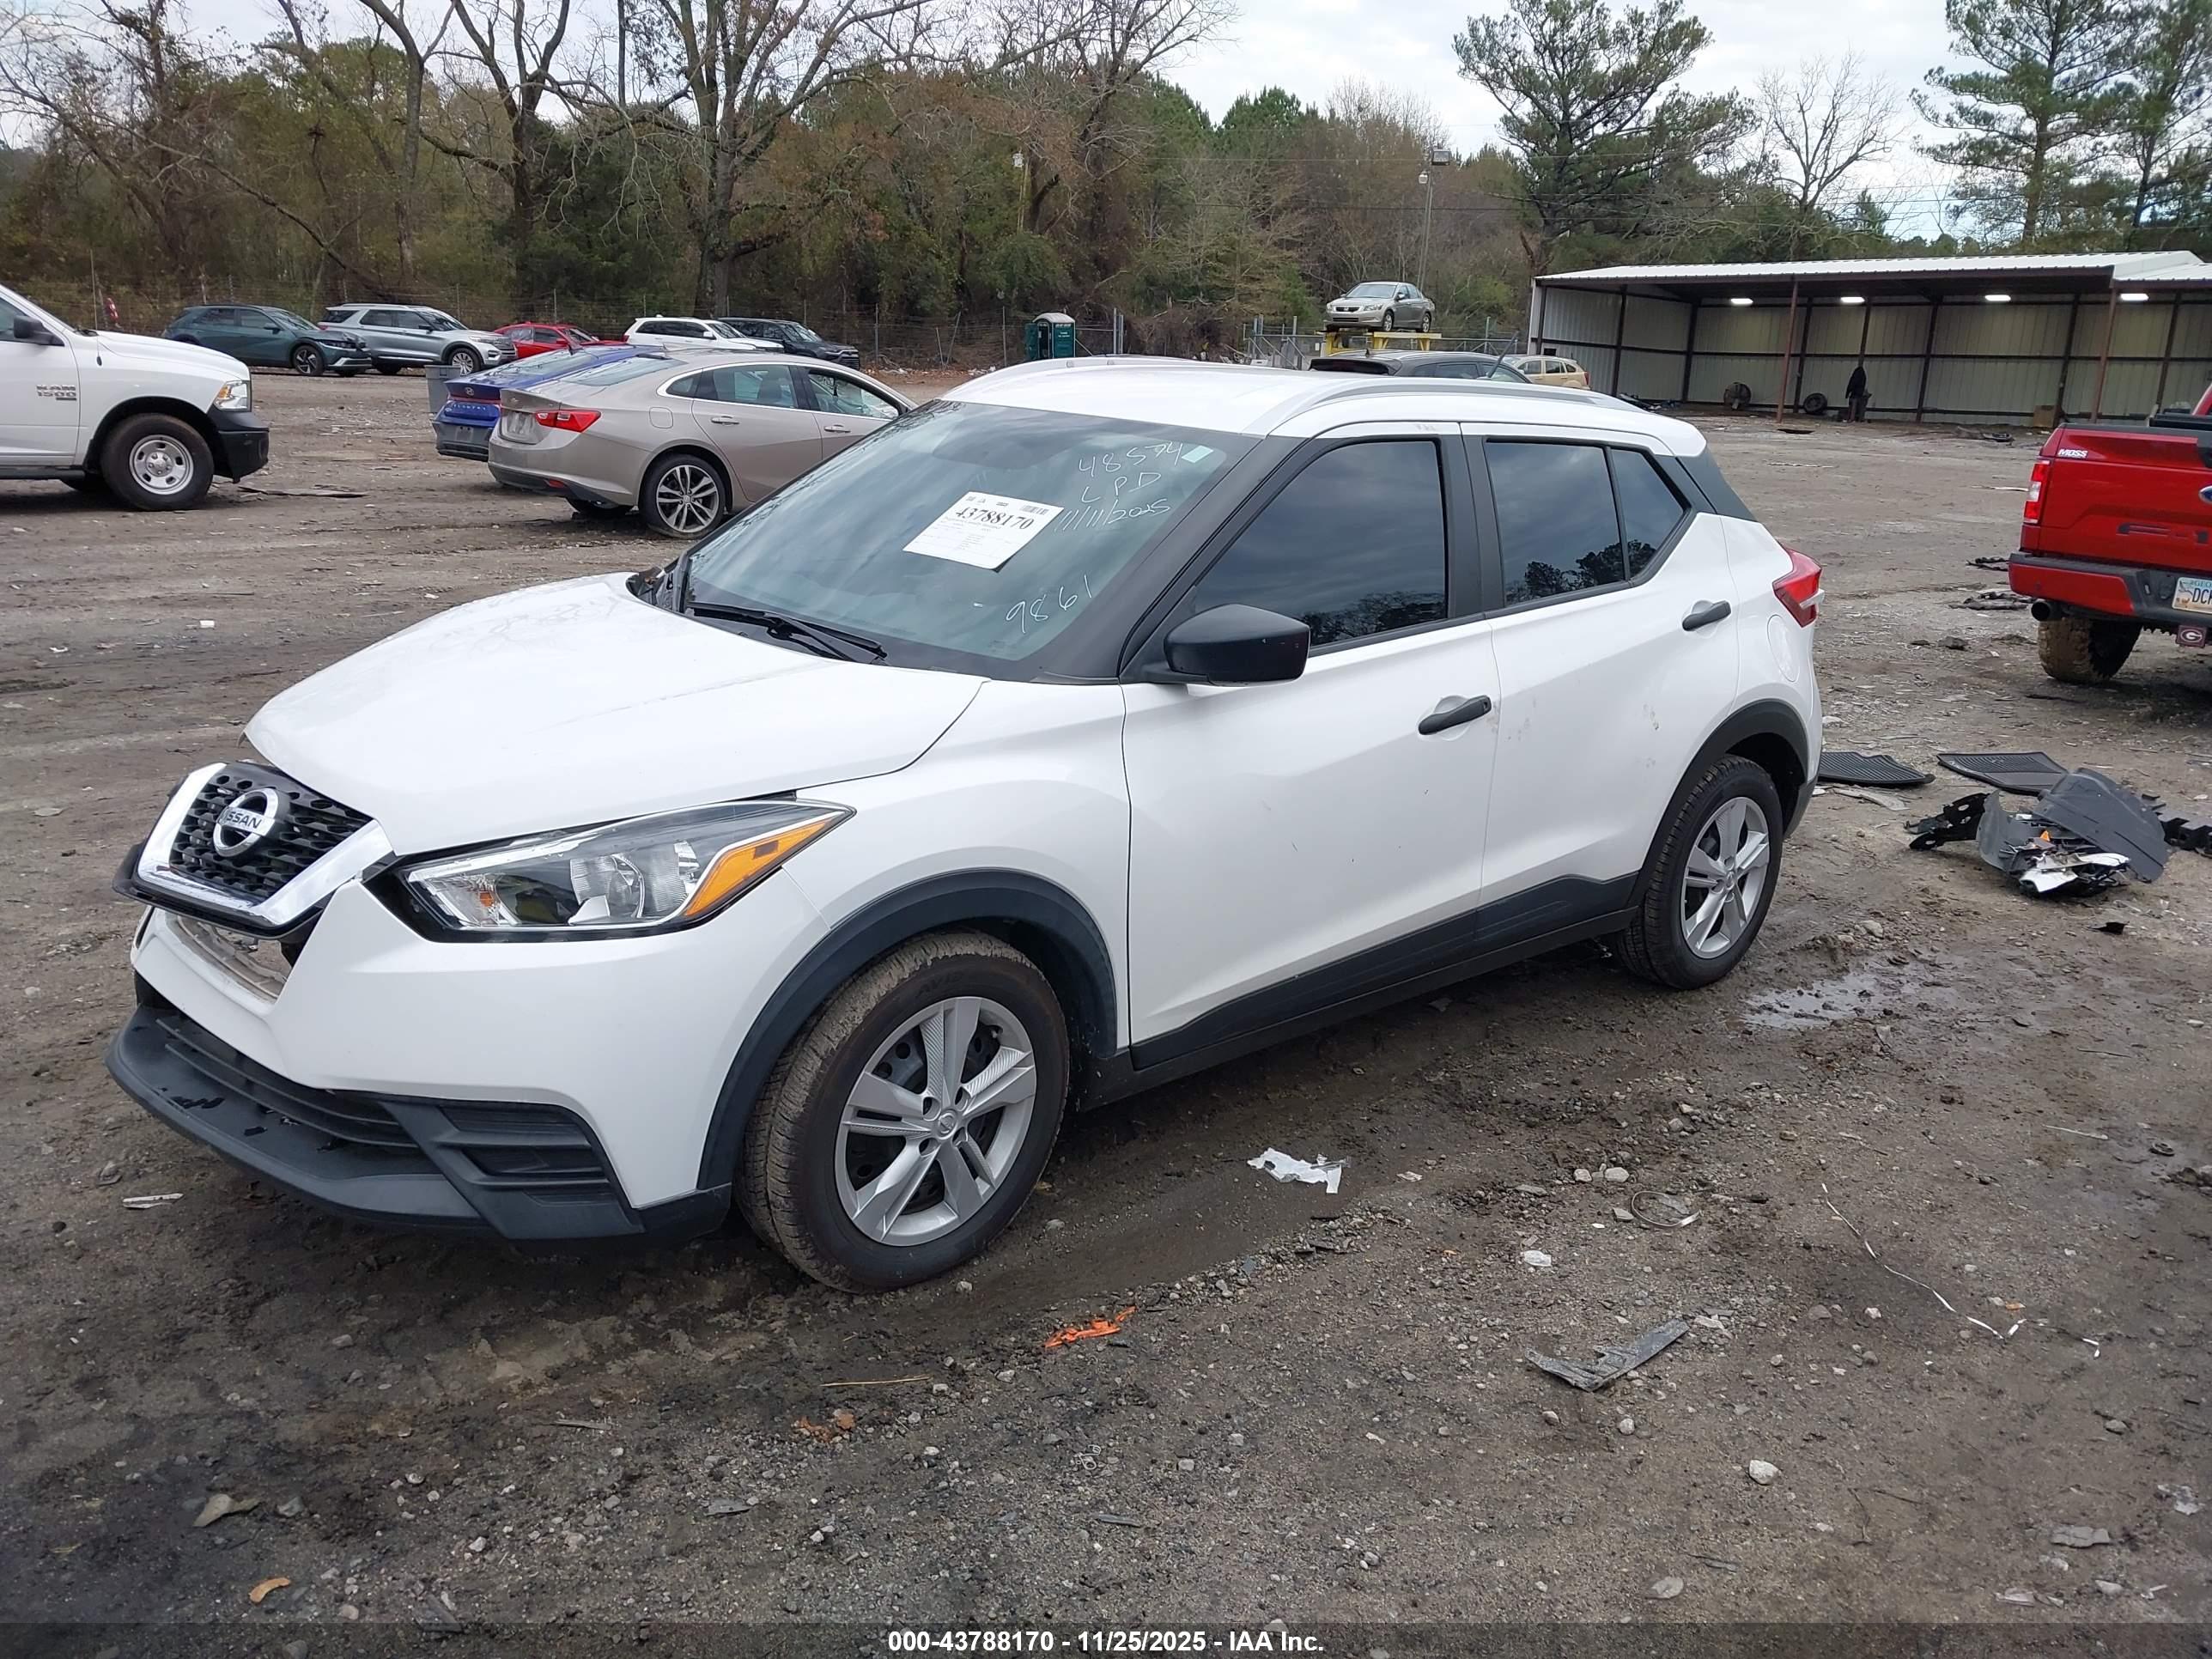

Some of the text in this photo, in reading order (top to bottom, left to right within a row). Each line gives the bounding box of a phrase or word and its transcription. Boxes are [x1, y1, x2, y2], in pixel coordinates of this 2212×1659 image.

[1079, 441, 1183, 477] 48574
[955, 506, 1035, 530] 43788170
[1006, 574, 1092, 634] 9861
[222, 811, 263, 830] SSAN
